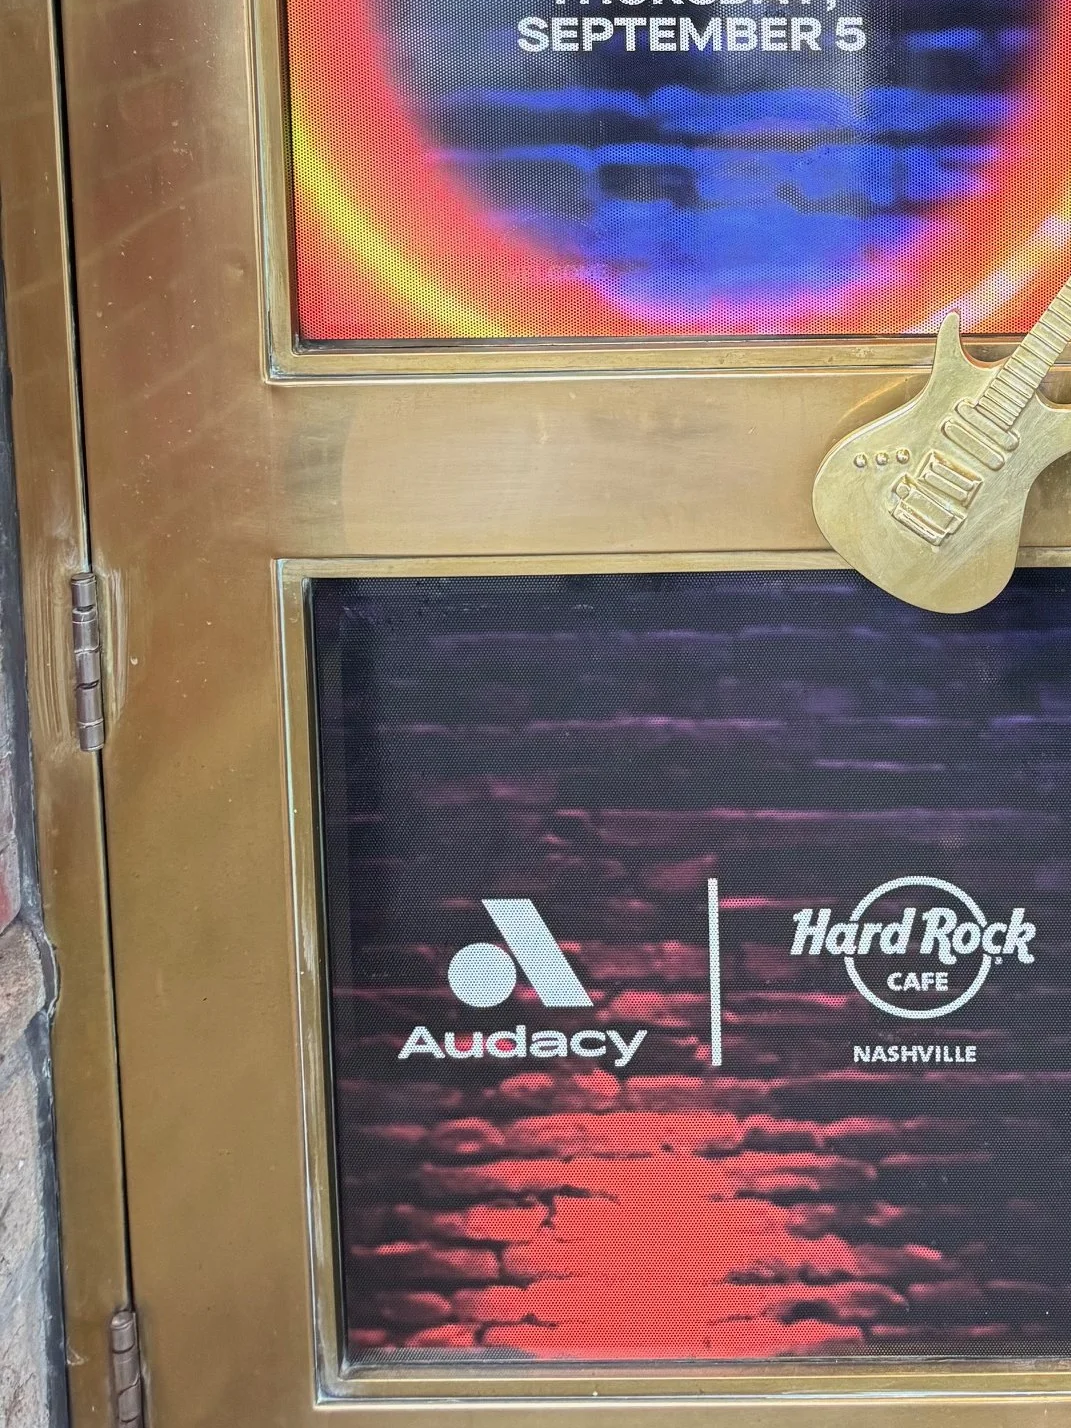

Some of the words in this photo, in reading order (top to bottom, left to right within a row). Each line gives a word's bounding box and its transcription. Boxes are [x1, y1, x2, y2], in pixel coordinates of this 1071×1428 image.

[517, 17, 820, 52] SEPTEMBER
[835, 17, 867, 52] 5
[791, 907, 914, 957] Hard
[915, 907, 1036, 965] Rock
[886, 971, 949, 992] CAFE
[398, 1025, 648, 1068] Audacy
[853, 1044, 977, 1064] NASHVILLE
